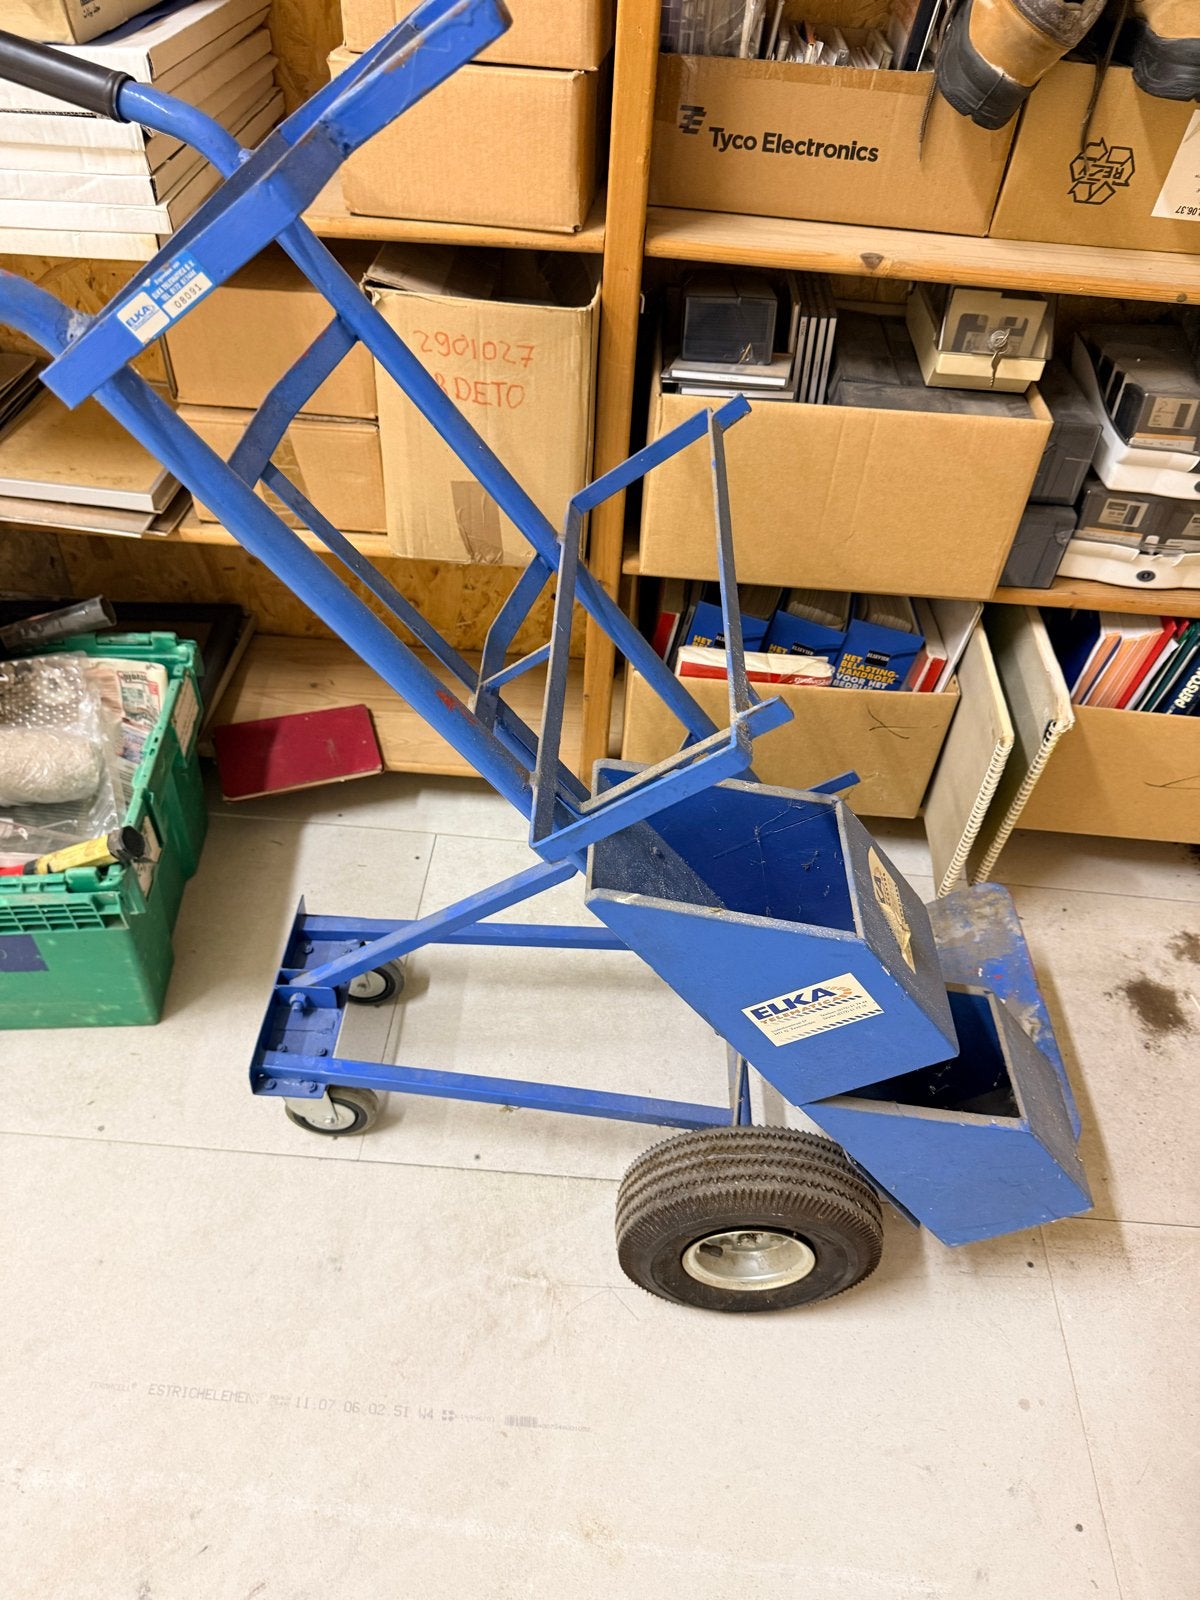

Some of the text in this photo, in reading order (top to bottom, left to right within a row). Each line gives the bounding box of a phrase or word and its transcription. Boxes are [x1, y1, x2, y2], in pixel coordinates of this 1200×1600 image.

[709, 126, 880, 163] Tyco Electronics
[174, 283, 202, 309] 08091
[126, 306, 150, 328] ELKA
[412, 329, 535, 368] 2901027
[693, 634, 712, 646] HET
[768, 643, 788, 655] HET
[843, 652, 863, 664] HET
[836, 673, 866, 686] VOOR
[868, 680, 888, 690] HET
[837, 667, 895, 685] HANDBOEK
[750, 987, 838, 1021] ELKA
[760, 996, 843, 1025] TELEMATICA
